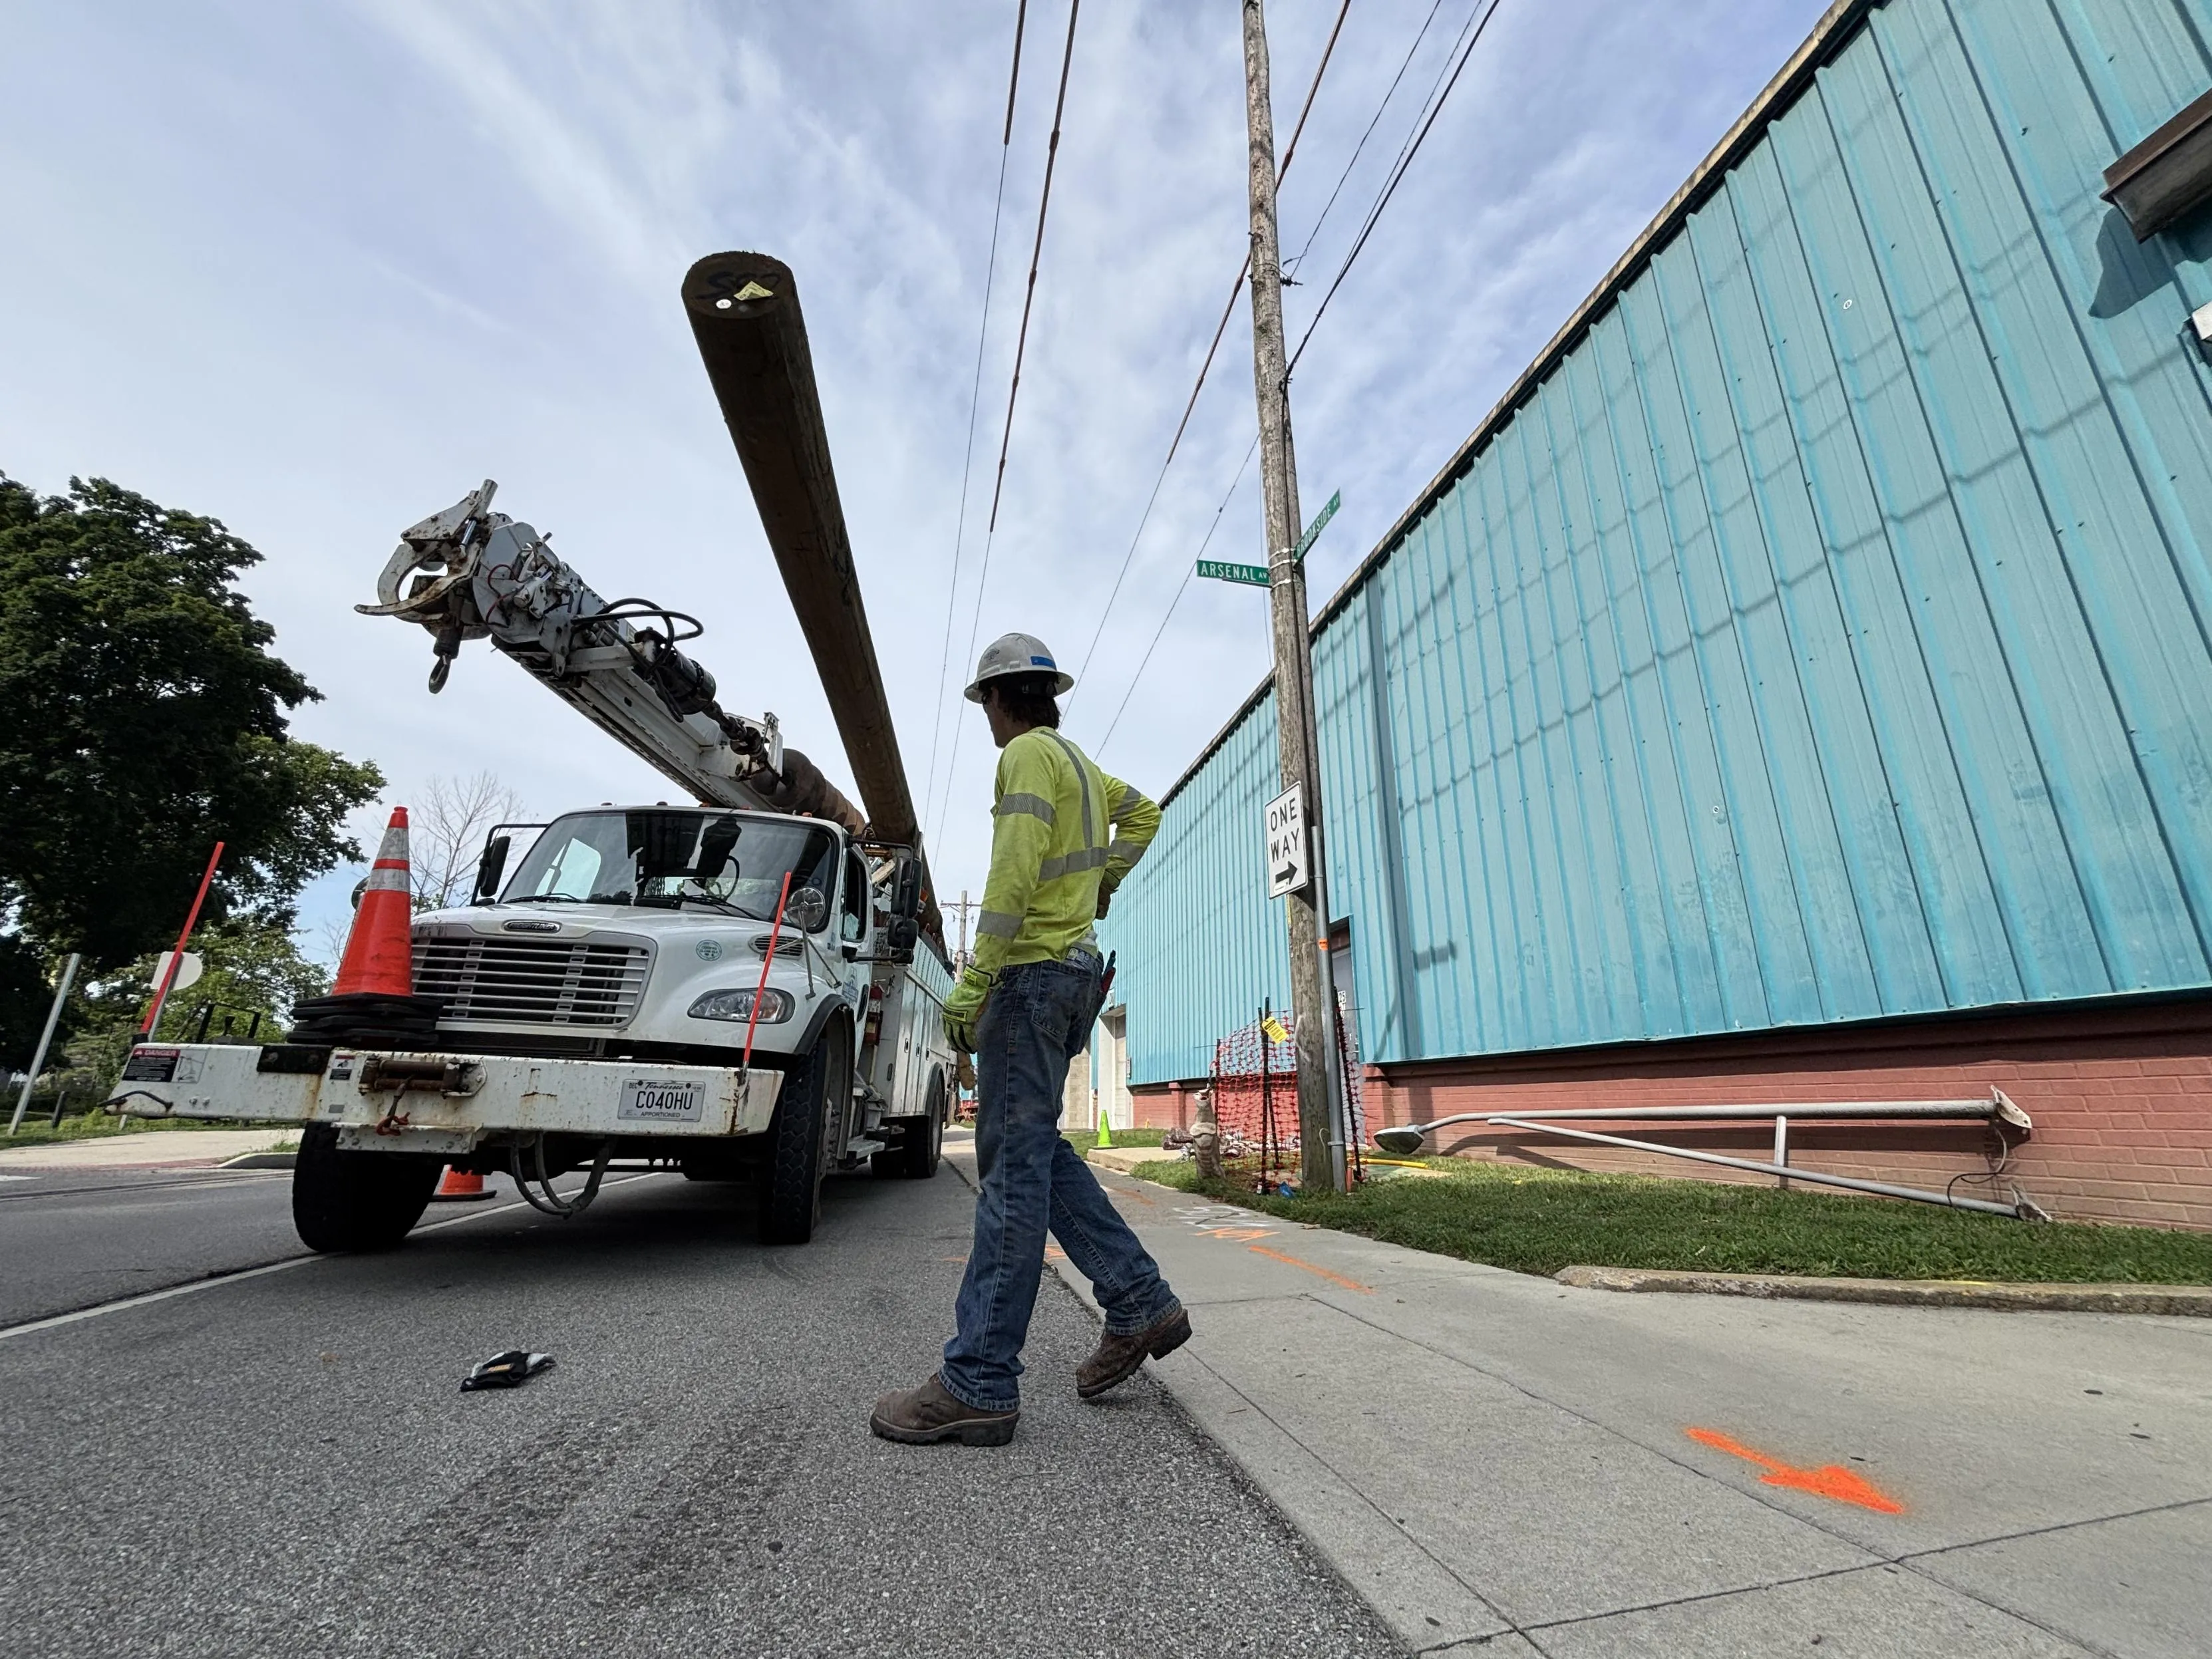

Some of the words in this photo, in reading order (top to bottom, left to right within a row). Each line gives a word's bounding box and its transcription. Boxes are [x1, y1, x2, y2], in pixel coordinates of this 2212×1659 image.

[1297, 505, 1332, 557] BROOKSIDE
[1201, 562, 1256, 581] ARSENAL
[1270, 797, 1298, 831] ONE
[1271, 827, 1300, 863] WAY
[645, 1082, 684, 1090] Tennessee
